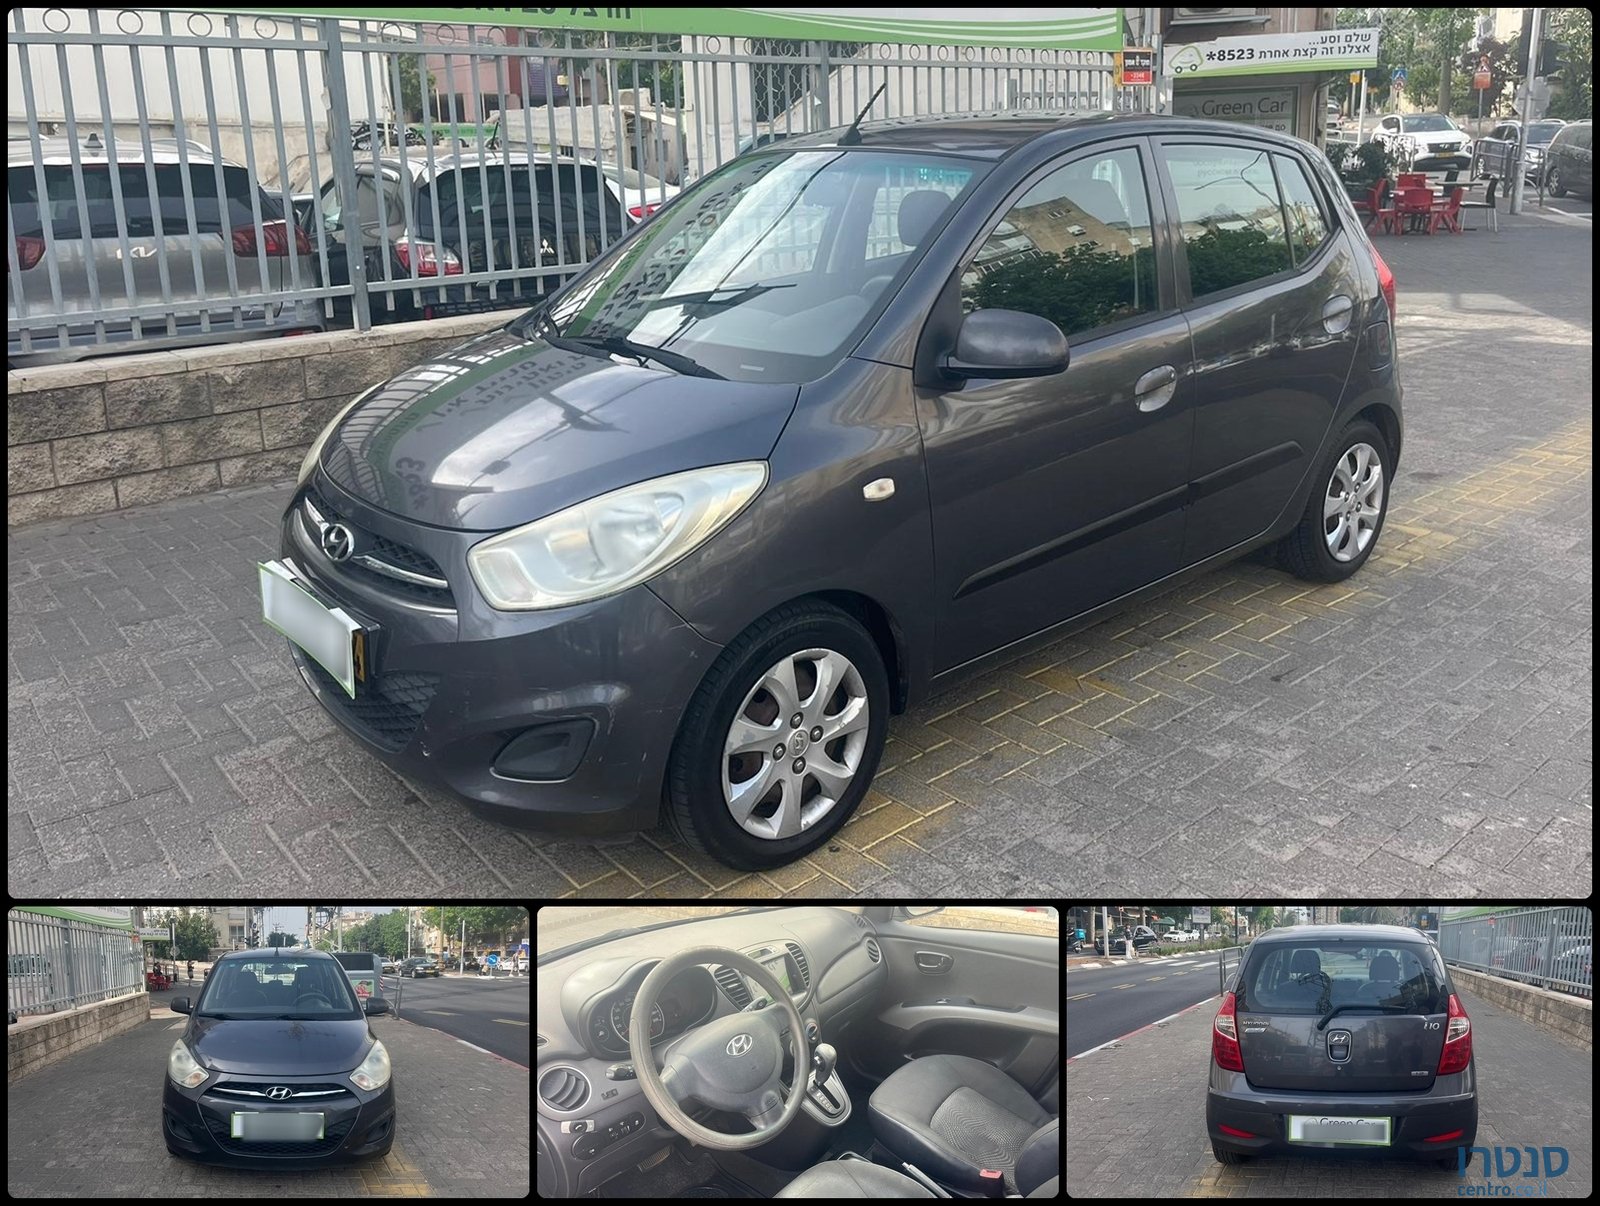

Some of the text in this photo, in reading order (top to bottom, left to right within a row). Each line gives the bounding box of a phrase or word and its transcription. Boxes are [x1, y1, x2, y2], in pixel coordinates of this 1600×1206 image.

[1344, 32, 1371, 43] שלם
[1258, 43, 1370, 59] אצלנו זה קצת אחרת
[1201, 97, 1288, 116] Green Car
